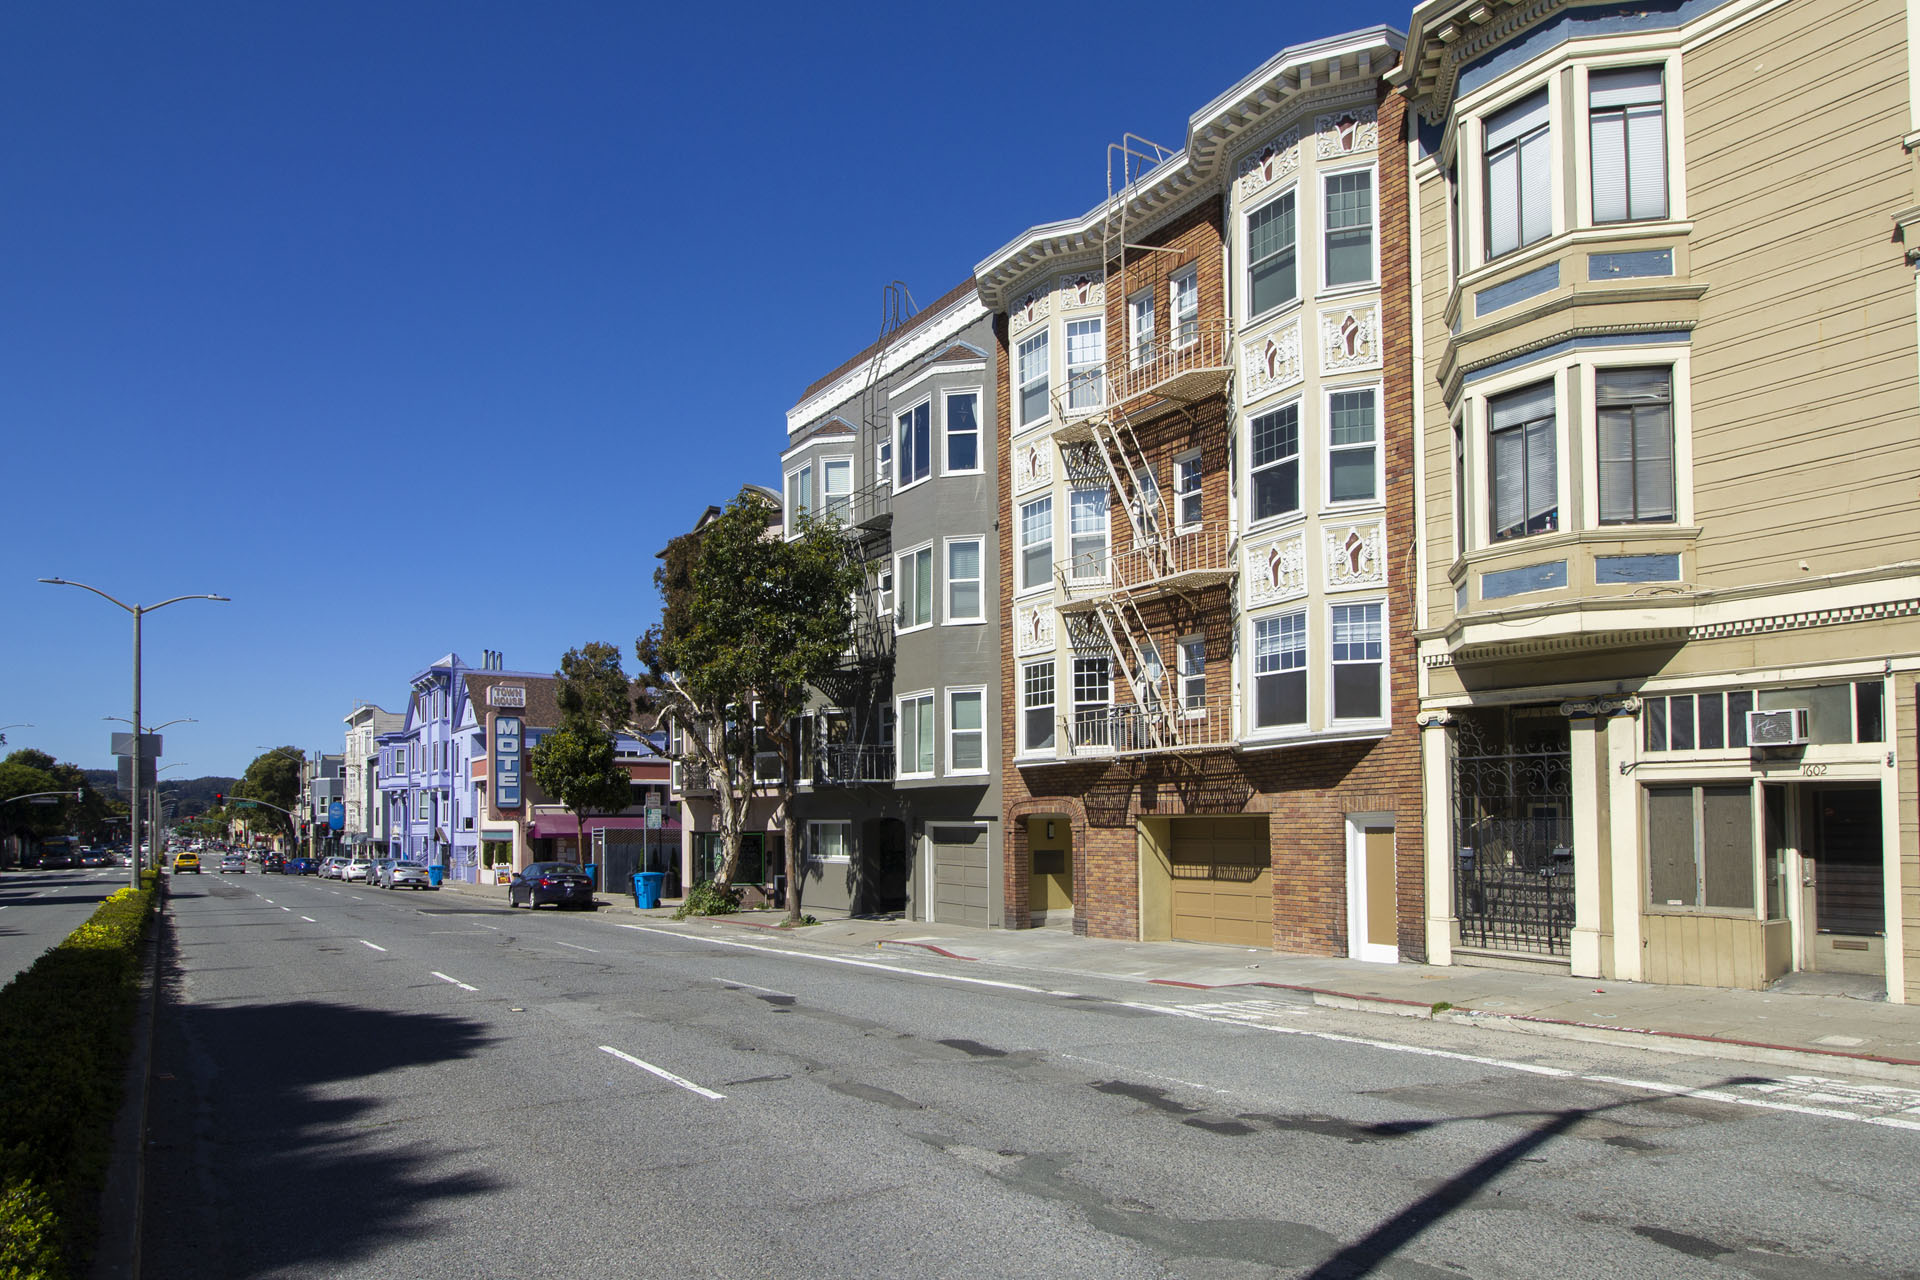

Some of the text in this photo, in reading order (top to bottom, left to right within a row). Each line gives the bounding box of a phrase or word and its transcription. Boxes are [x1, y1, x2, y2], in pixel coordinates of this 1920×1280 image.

[494, 687, 522, 697] TOWN
[494, 696, 524, 706] HOUSE
[497, 720, 519, 804] MOTEL
[1803, 764, 1827, 777] 1602
